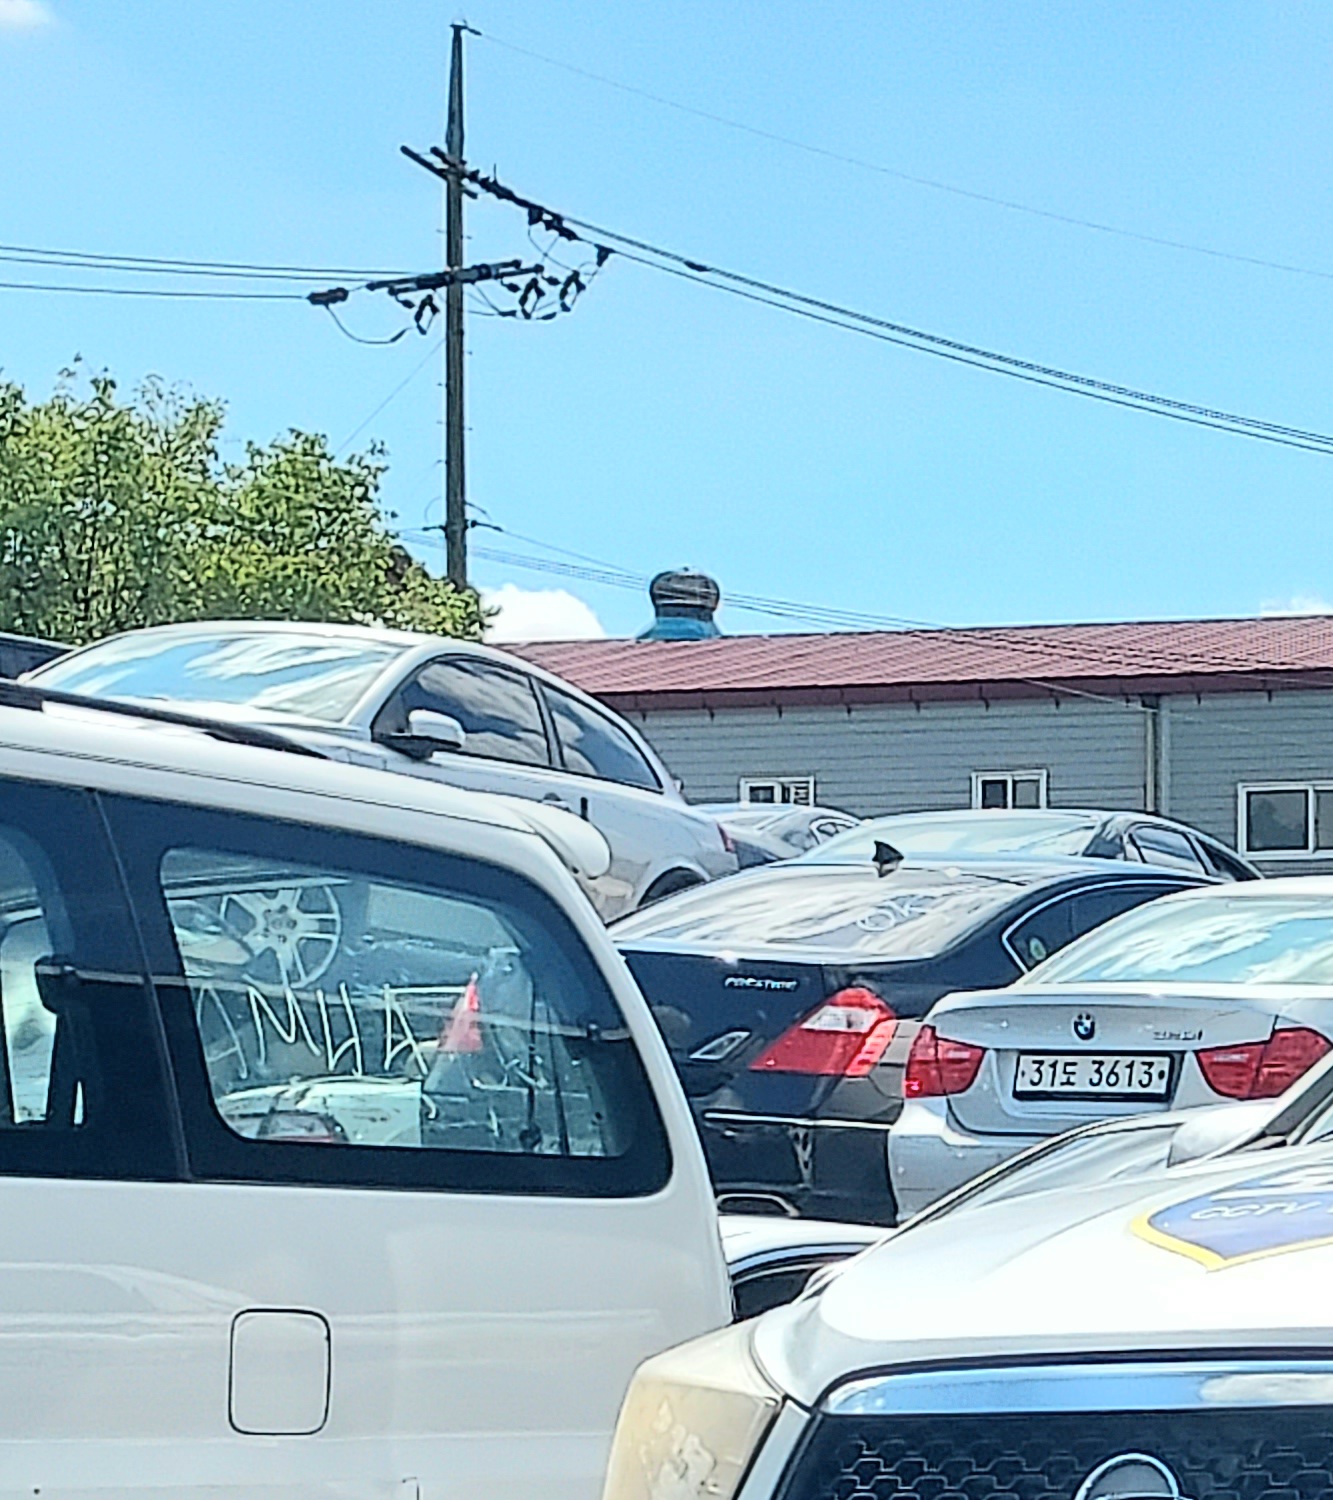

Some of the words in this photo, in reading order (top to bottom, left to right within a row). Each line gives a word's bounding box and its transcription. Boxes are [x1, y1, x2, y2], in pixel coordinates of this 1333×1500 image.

[1029, 1059, 1078, 1087] 31도
[1089, 1060, 1155, 1088] 3613
[1191, 1200, 1321, 1221] CCTV
